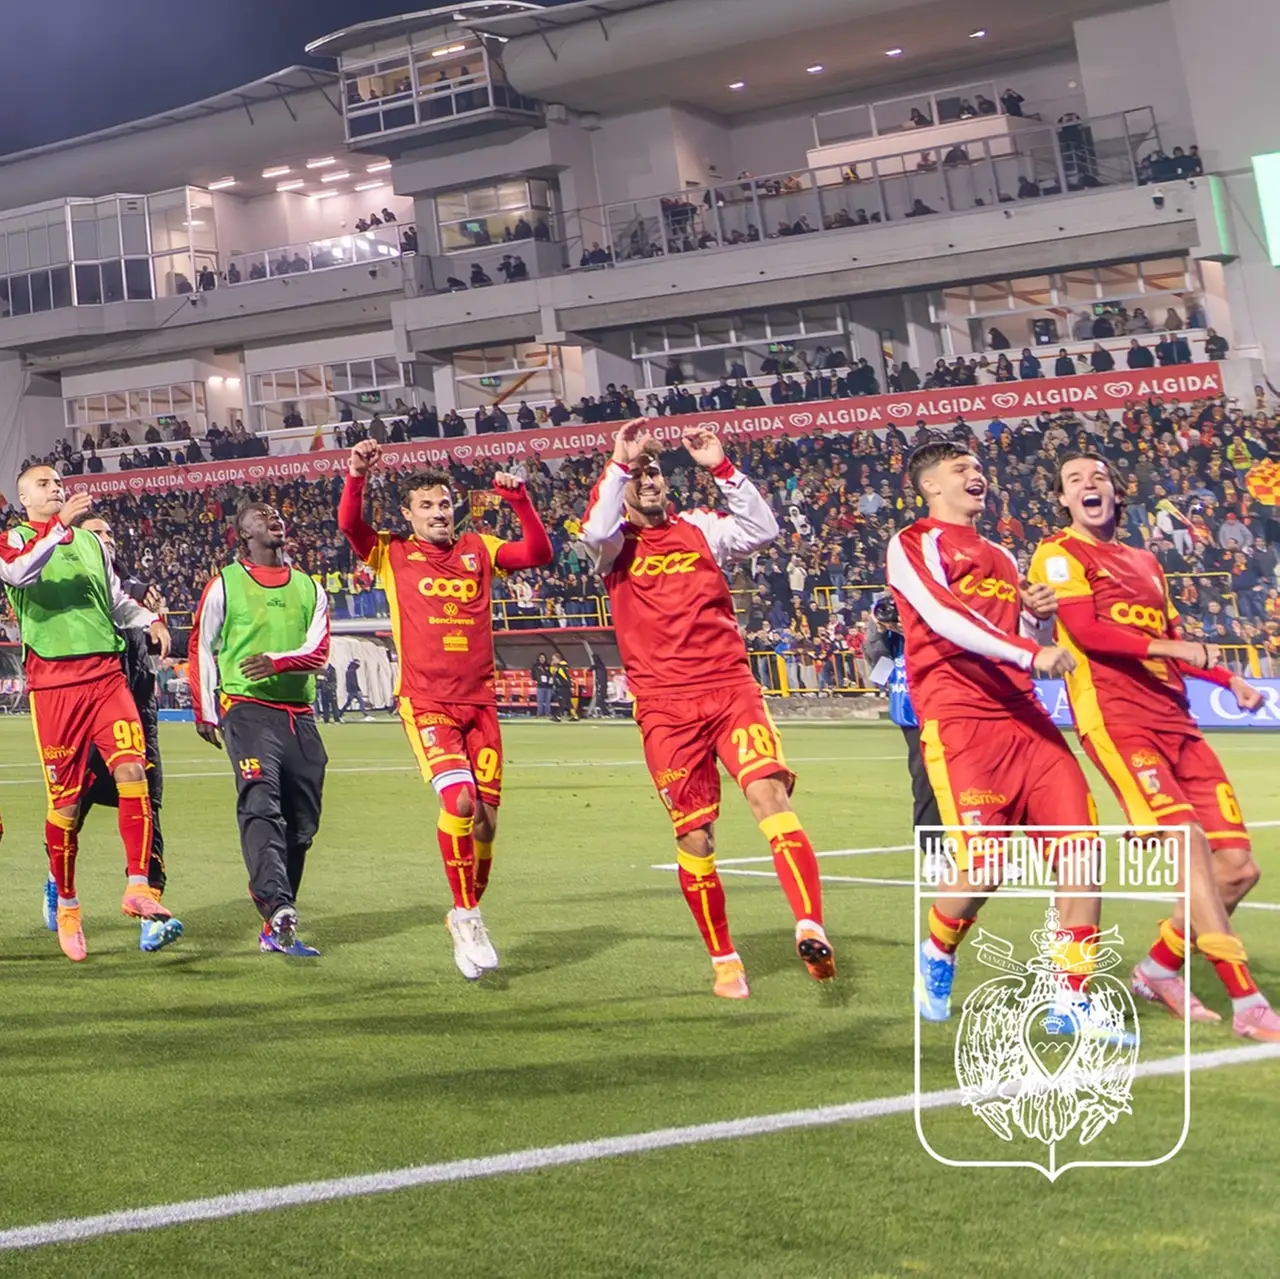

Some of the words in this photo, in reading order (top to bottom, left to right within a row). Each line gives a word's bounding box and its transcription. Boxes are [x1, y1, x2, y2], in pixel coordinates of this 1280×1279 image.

[90, 480, 127, 493] ALGIDA
[145, 475, 185, 488] ALGIDA
[204, 470, 245, 482] ALGIDA
[267, 463, 310, 477] ALGIDA
[402, 448, 449, 464] ALGIDA
[475, 442, 526, 458] ALGIDA
[552, 433, 607, 449] ALGIDA
[722, 417, 784, 433] ALGIDA
[816, 407, 882, 425] ALGIDA
[916, 398, 986, 415] ALGIDA
[1022, 386, 1098, 406] ALGIDA
[1137, 375, 1218, 396] ALGIDA
[630, 552, 701, 577] USCZ
[418, 577, 478, 603] coop
[113, 719, 146, 753] 98
[731, 723, 776, 765] 28
